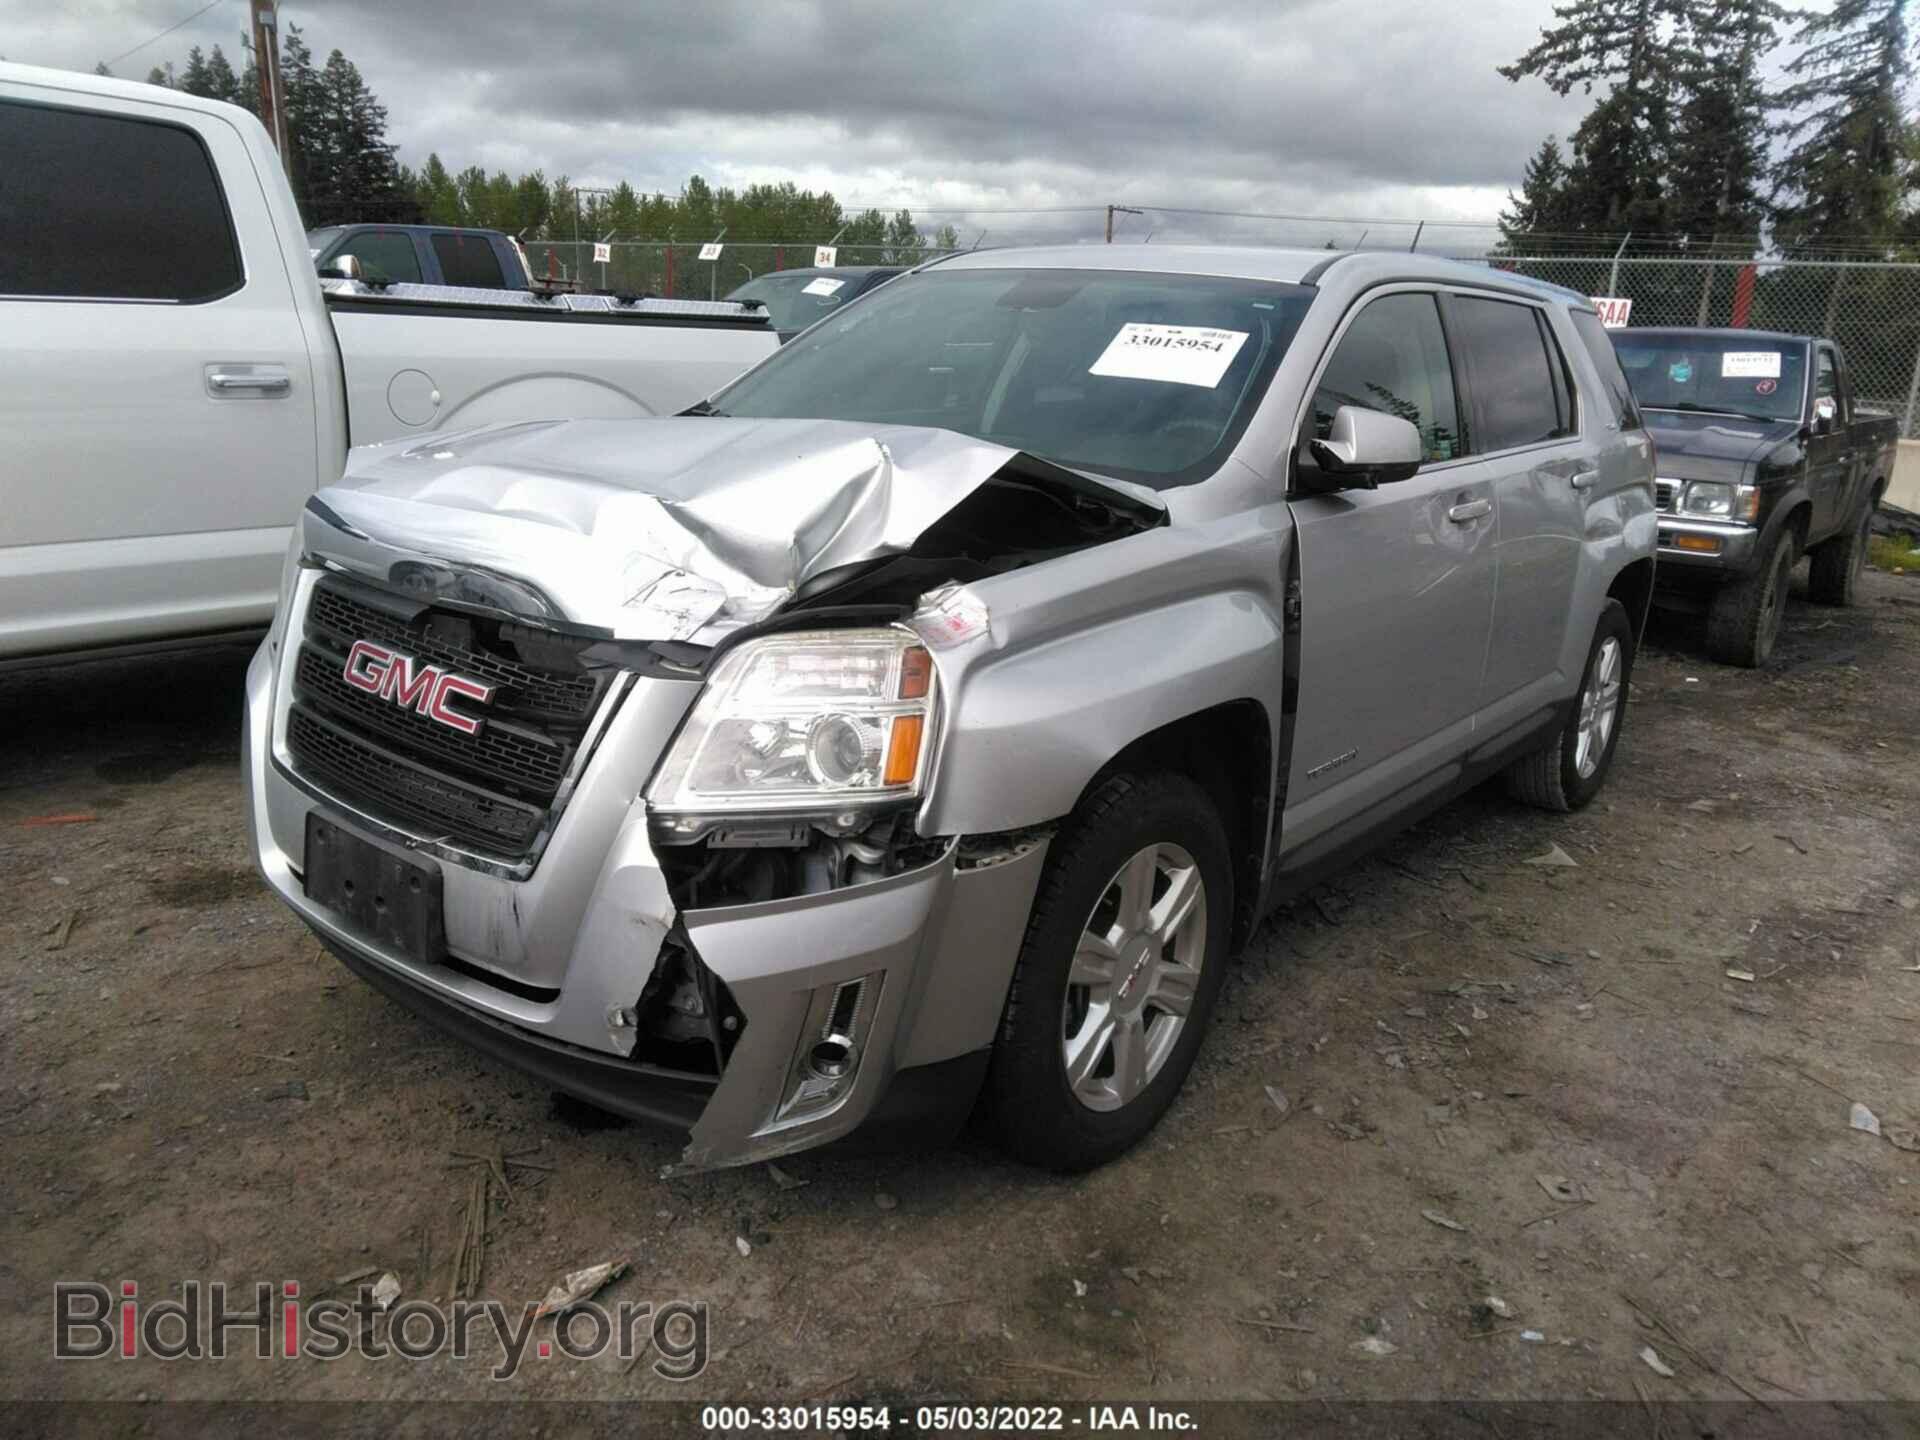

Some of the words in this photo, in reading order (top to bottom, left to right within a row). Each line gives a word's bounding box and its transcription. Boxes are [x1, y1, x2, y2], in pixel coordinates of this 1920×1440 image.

[820, 251, 831, 264] 34
[1124, 334, 1224, 353] 33015954
[343, 640, 493, 736] GMC
